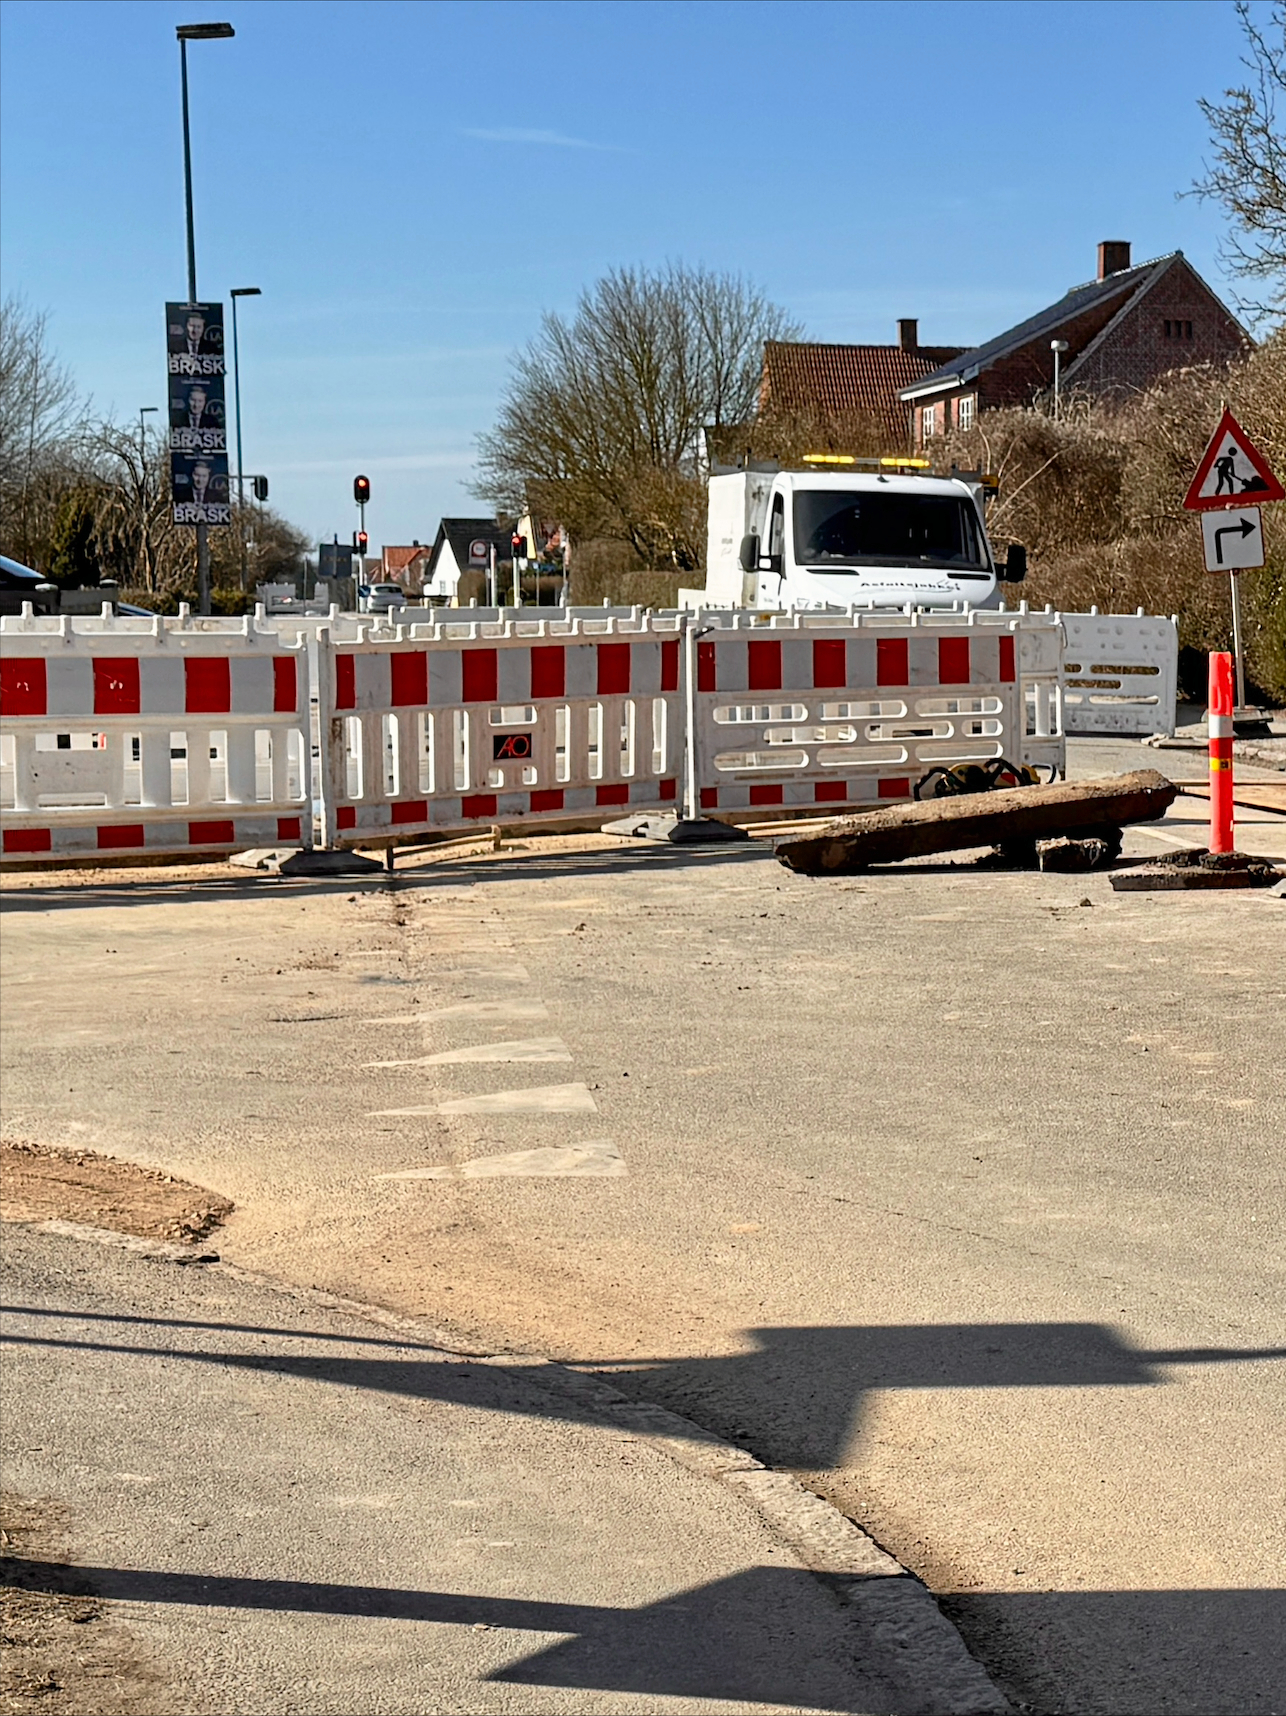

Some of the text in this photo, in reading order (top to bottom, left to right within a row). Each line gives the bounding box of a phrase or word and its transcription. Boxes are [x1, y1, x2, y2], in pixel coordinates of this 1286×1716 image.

[169, 360, 224, 375] BRASK
[170, 433, 225, 448] BRASK
[173, 508, 230, 522] BRASK
